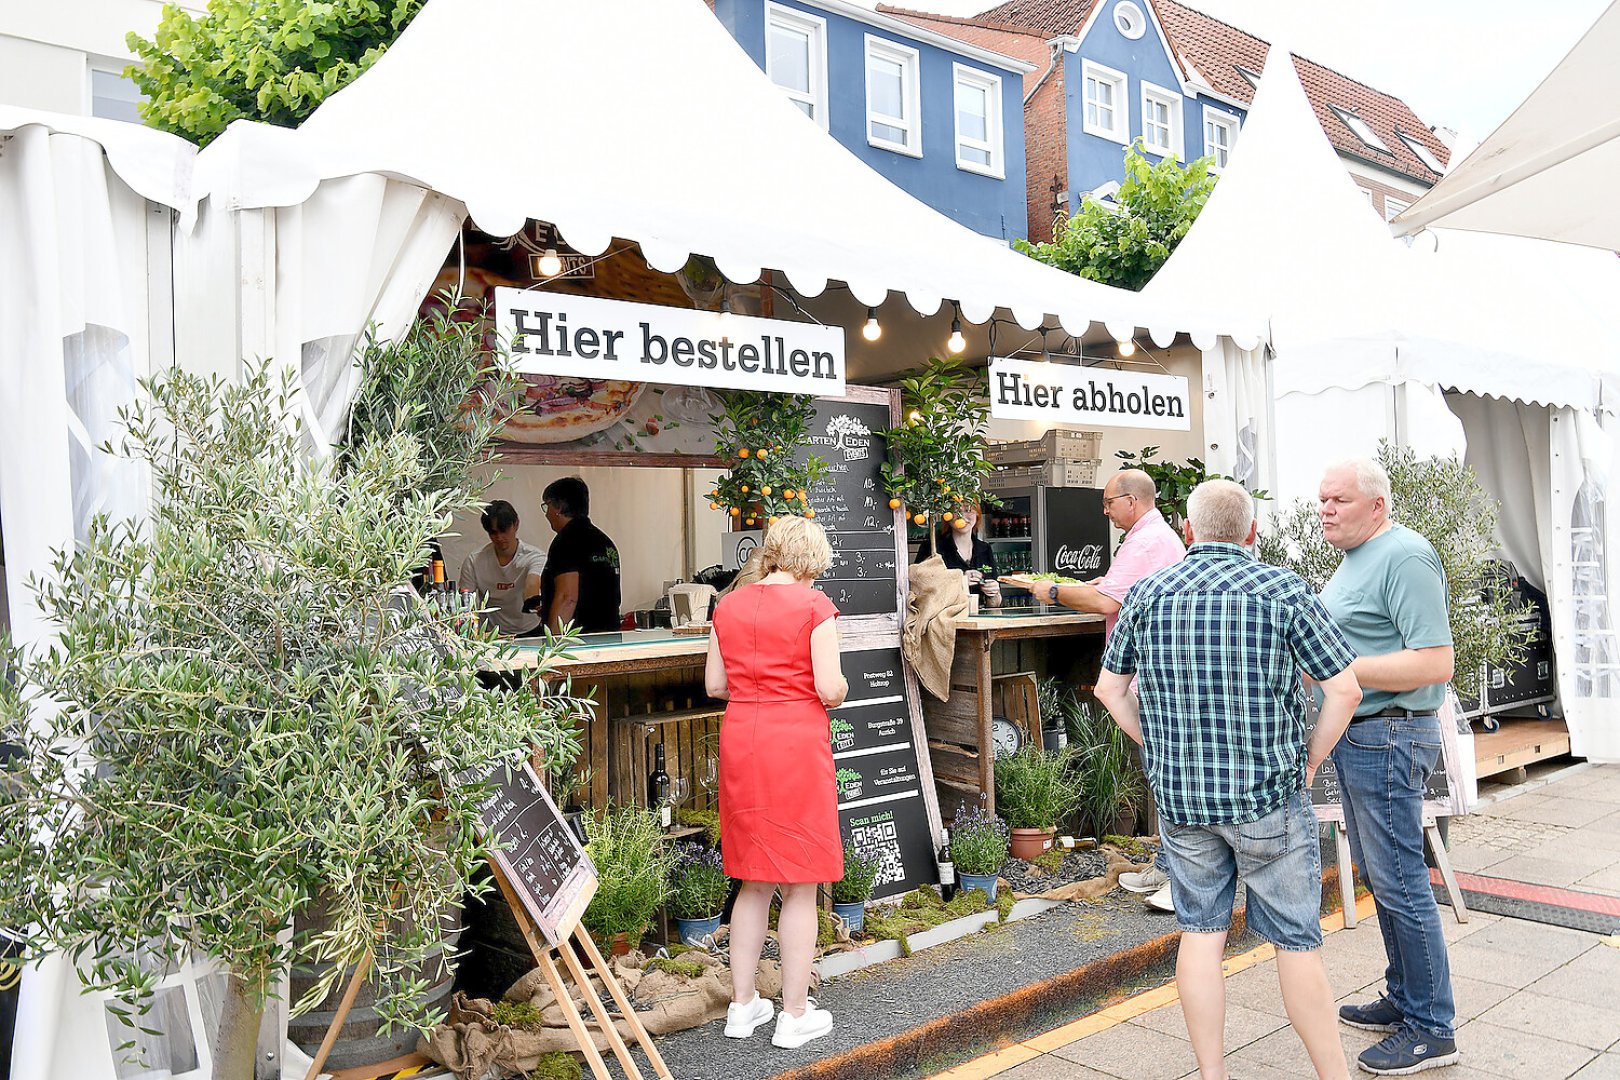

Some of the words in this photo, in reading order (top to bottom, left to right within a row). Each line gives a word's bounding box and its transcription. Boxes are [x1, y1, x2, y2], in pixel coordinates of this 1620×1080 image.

[509, 308, 624, 361] Hier
[638, 322, 837, 380] bestellen
[996, 371, 1064, 408] Hier
[1072, 381, 1185, 418] abholen
[845, 436, 870, 447] EDEN
[849, 817, 870, 827] Scan
[870, 811, 894, 822] mich!
